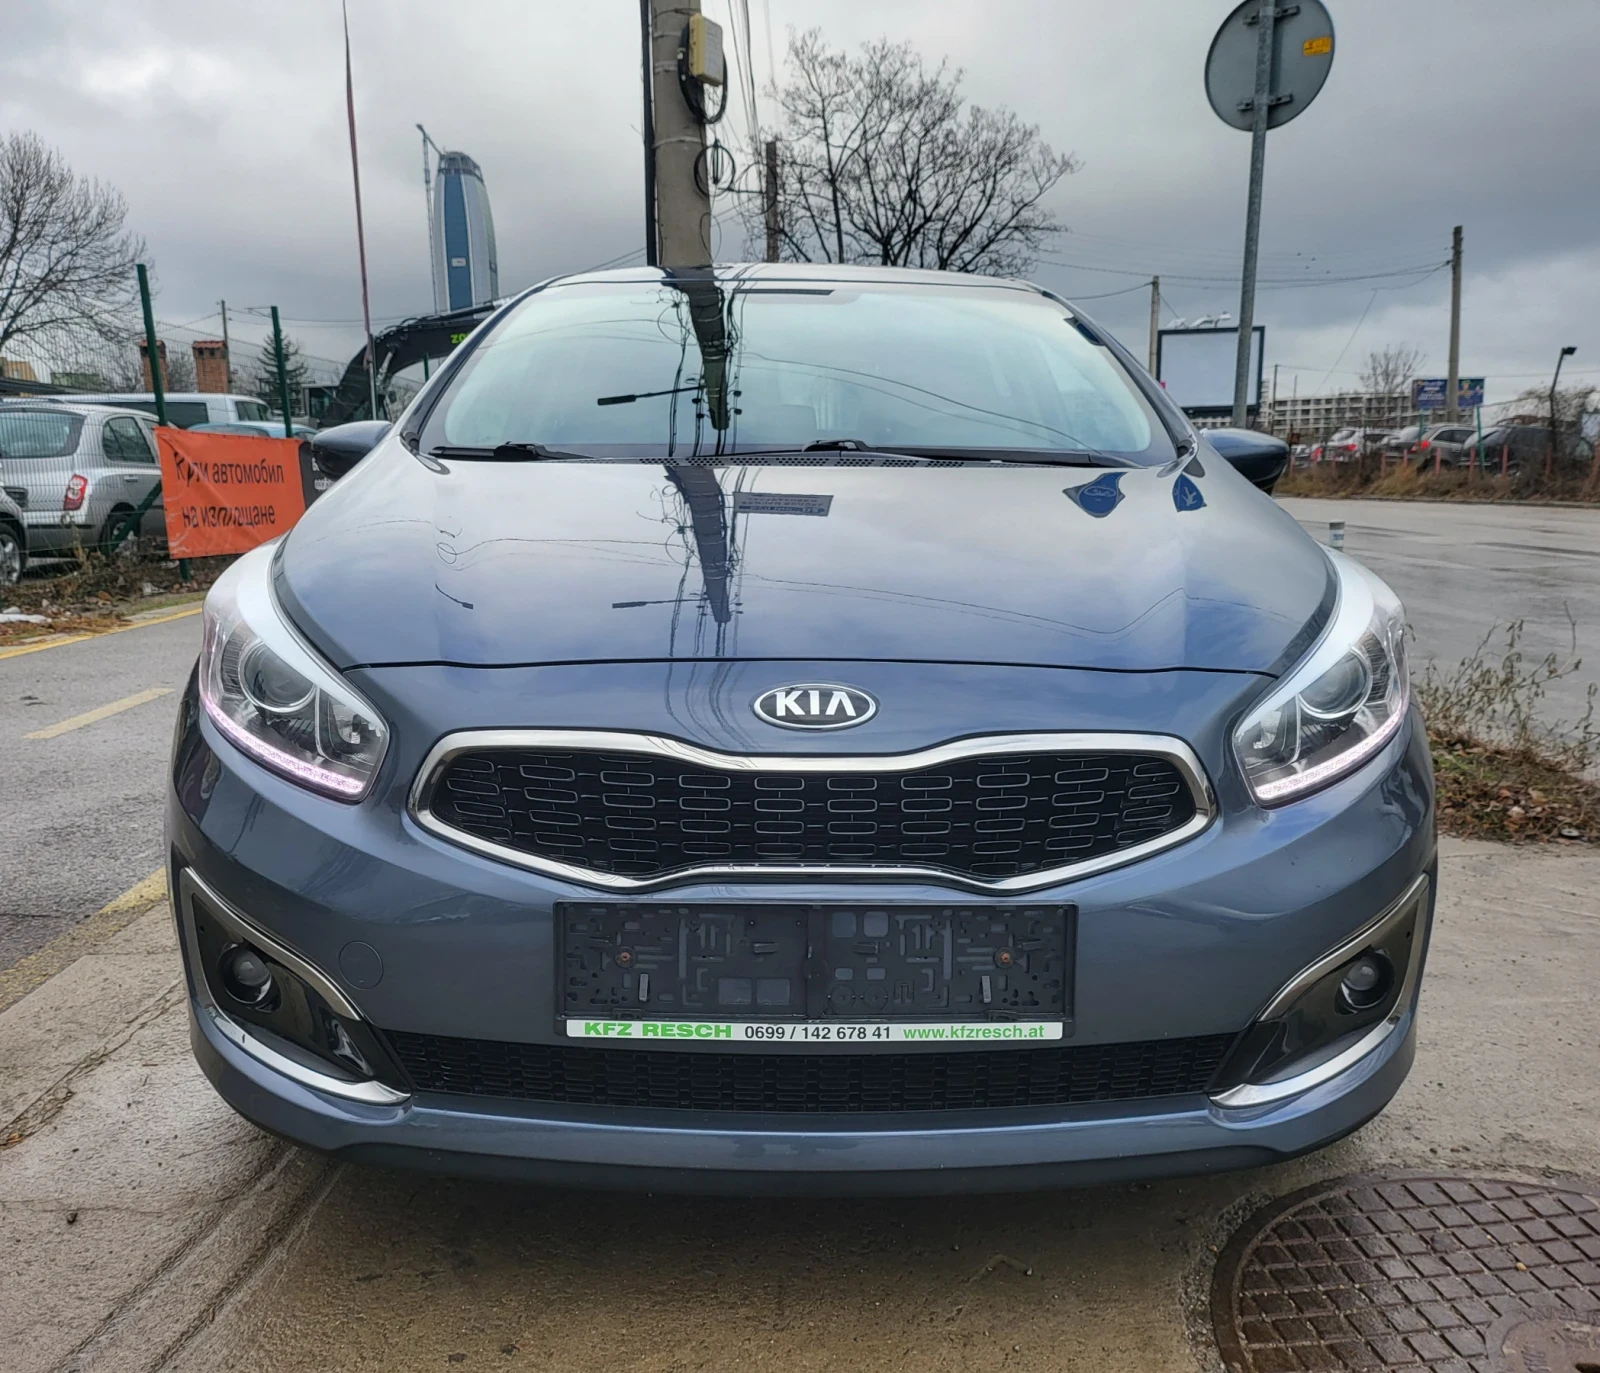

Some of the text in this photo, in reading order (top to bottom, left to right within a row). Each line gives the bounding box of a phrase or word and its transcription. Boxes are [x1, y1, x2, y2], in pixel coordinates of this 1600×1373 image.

[212, 458, 285, 484] автомобил
[182, 505, 276, 529] на изплащане
[775, 690, 857, 717] KIA
[584, 1022, 1045, 1041] KFZ RESCH 0699 / 142 678 41 www.kfzresch.at
